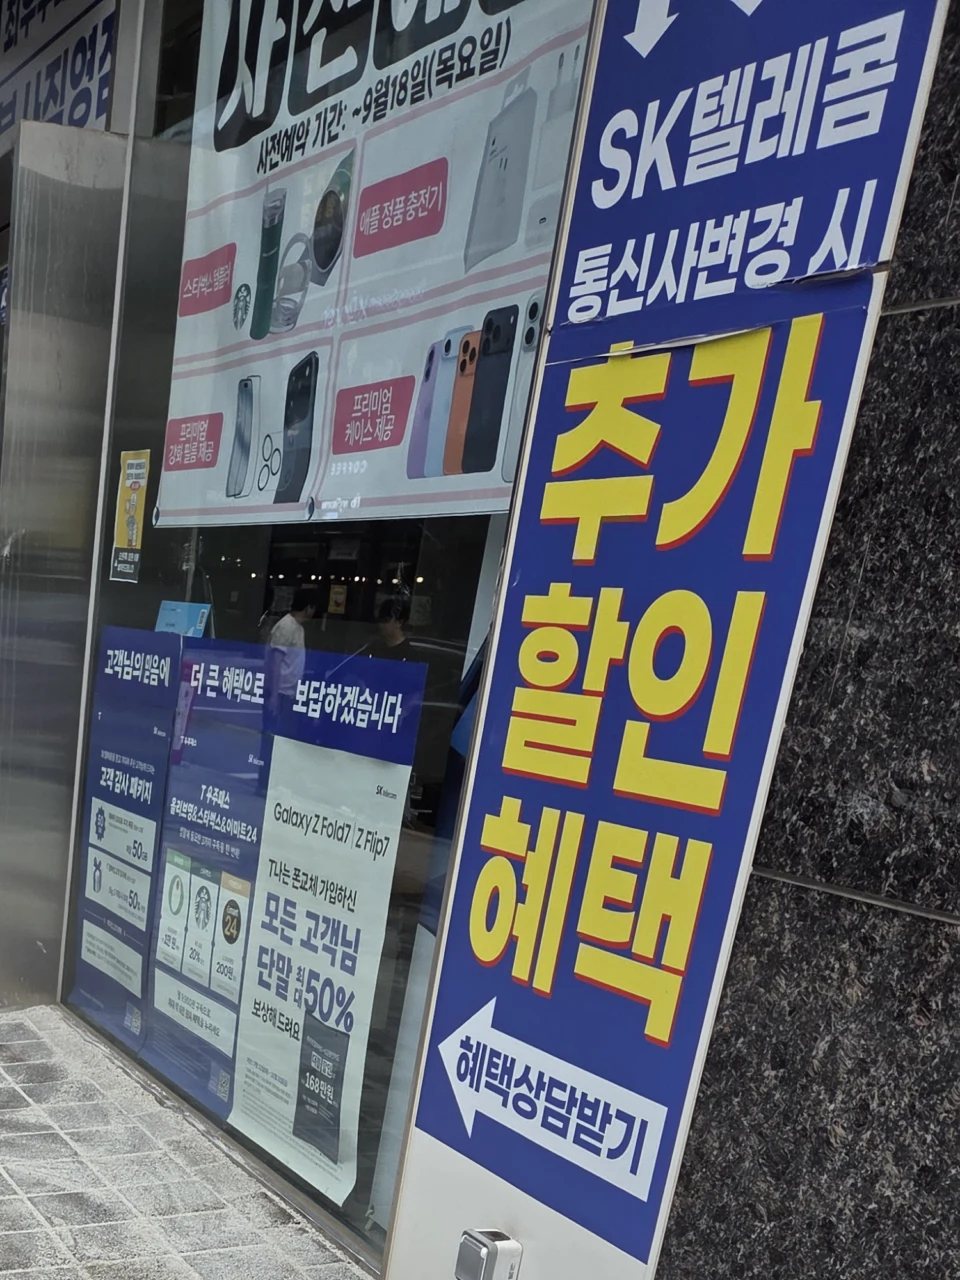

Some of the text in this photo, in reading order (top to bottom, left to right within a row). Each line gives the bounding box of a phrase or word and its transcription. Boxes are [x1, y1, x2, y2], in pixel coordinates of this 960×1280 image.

[256, 117, 310, 175] 사전예약
[312, 99, 347, 150] 기간:
[591, 10, 906, 210] SK텔레콤
[359, 180, 442, 236] 애플 정품 충전기
[567, 179, 879, 325] 통신사변경 시
[182, 276, 213, 299] 스타벅스
[179, 420, 209, 439] 프리미엄
[344, 414, 396, 446] 케이스 제공
[352, 387, 392, 416] 프리미엄
[198, 440, 214, 462] 제공
[540, 313, 824, 564] 추가
[105, 650, 144, 682] 고객님의
[191, 662, 204, 695] 더
[206, 665, 219, 698] 큰
[223, 666, 265, 705] 혜택으로
[292, 679, 403, 733] 보답하겠습니다
[501, 583, 768, 817] 할인
[100, 766, 114, 791] 고객
[115, 770, 129, 796] 감사
[376, 785, 397, 800] SK telecom
[274, 802, 390, 861] Galaxy Z Fold7 Z Flip7
[292, 865, 318, 898] 폰교체
[318, 878, 358, 913] 가입하신
[223, 916, 238, 939] 24
[261, 891, 361, 977] 모든 고객님
[469, 797, 714, 1048] 혜택
[257, 944, 292, 1002] 단말
[304, 968, 356, 1033] 50%
[251, 998, 301, 1042] 보상해 드려요
[455, 1035, 649, 1176] 혜택상담받기
